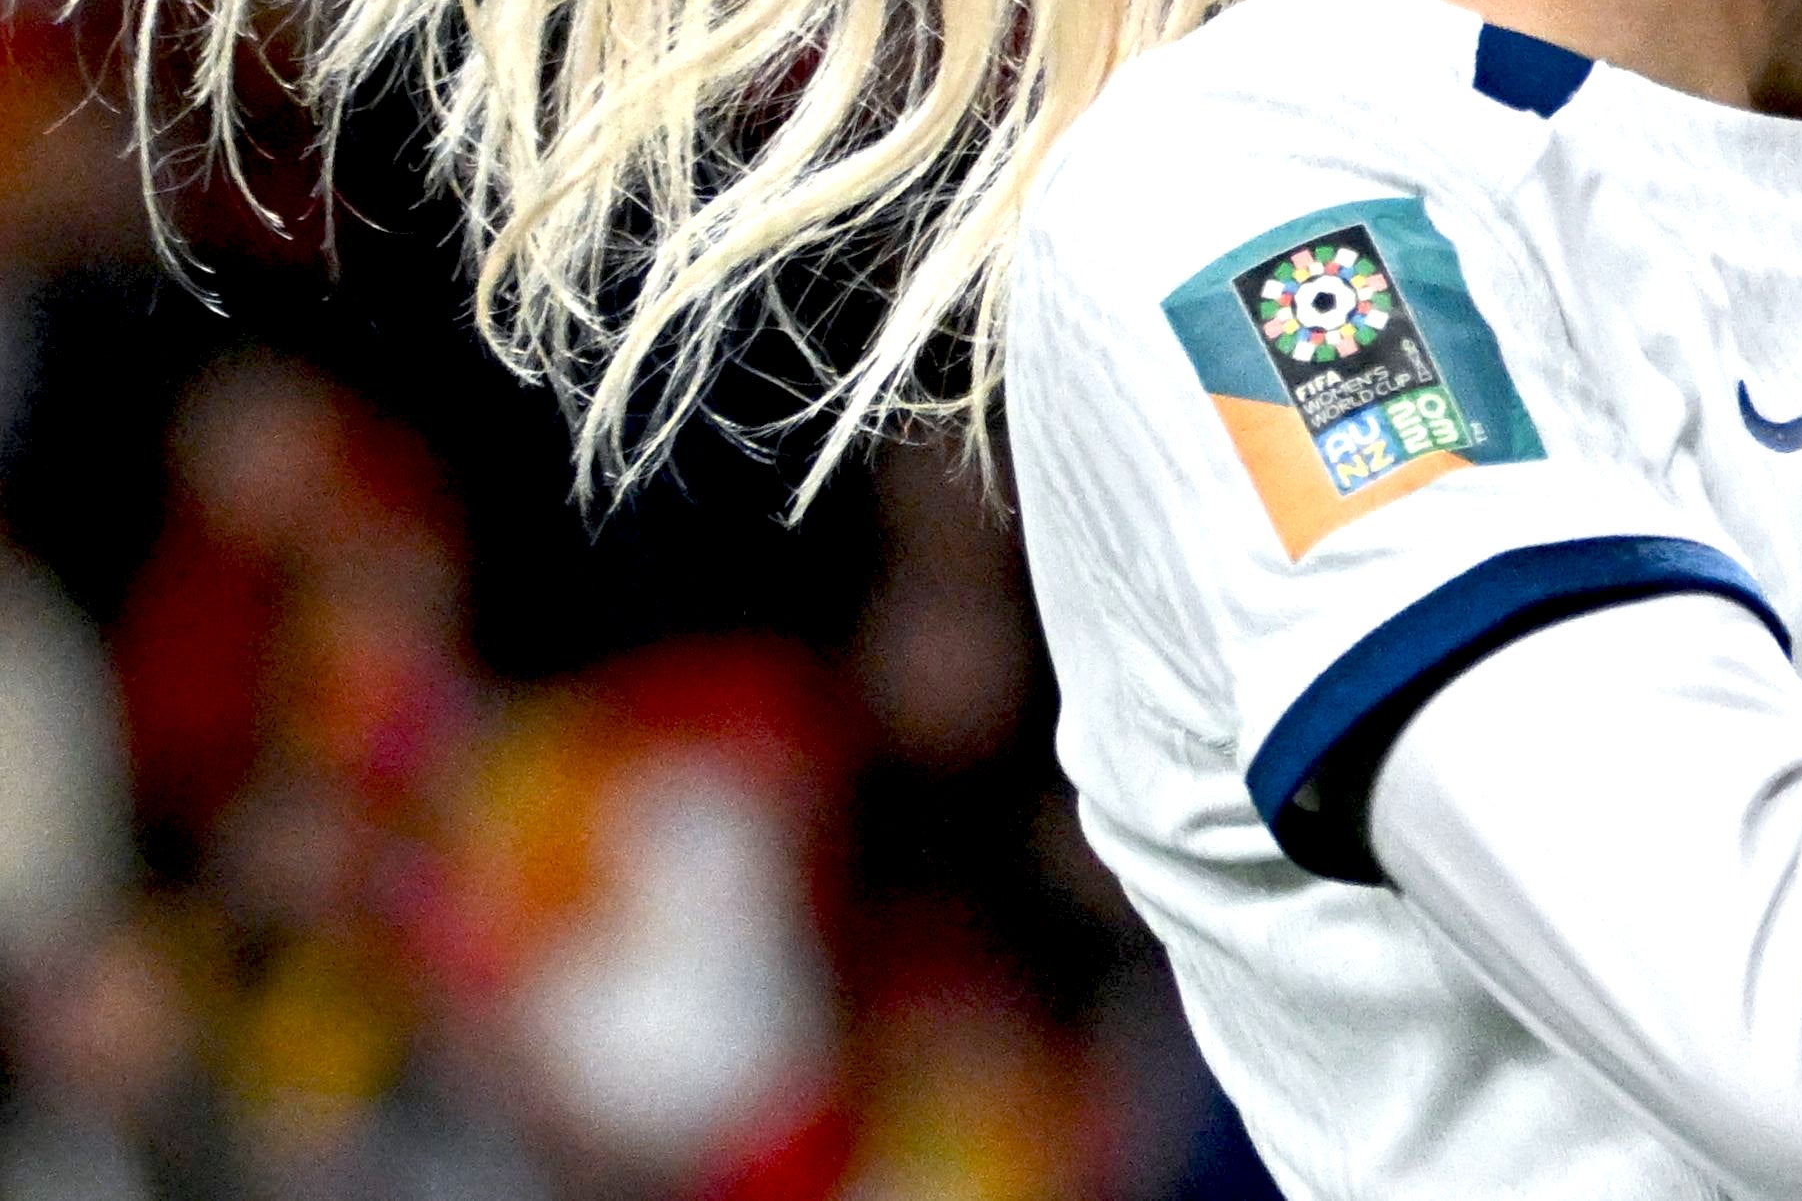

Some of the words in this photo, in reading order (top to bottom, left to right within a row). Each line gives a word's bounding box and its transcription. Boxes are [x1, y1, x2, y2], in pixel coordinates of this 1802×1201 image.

[1296, 370, 1342, 402] FIFA
[1303, 366, 1389, 415] WOMEN'S
[1310, 390, 1374, 428] WORLD
[1376, 373, 1411, 397] CUP
[1325, 415, 1381, 463] AU
[1337, 440, 1395, 487] NZ
